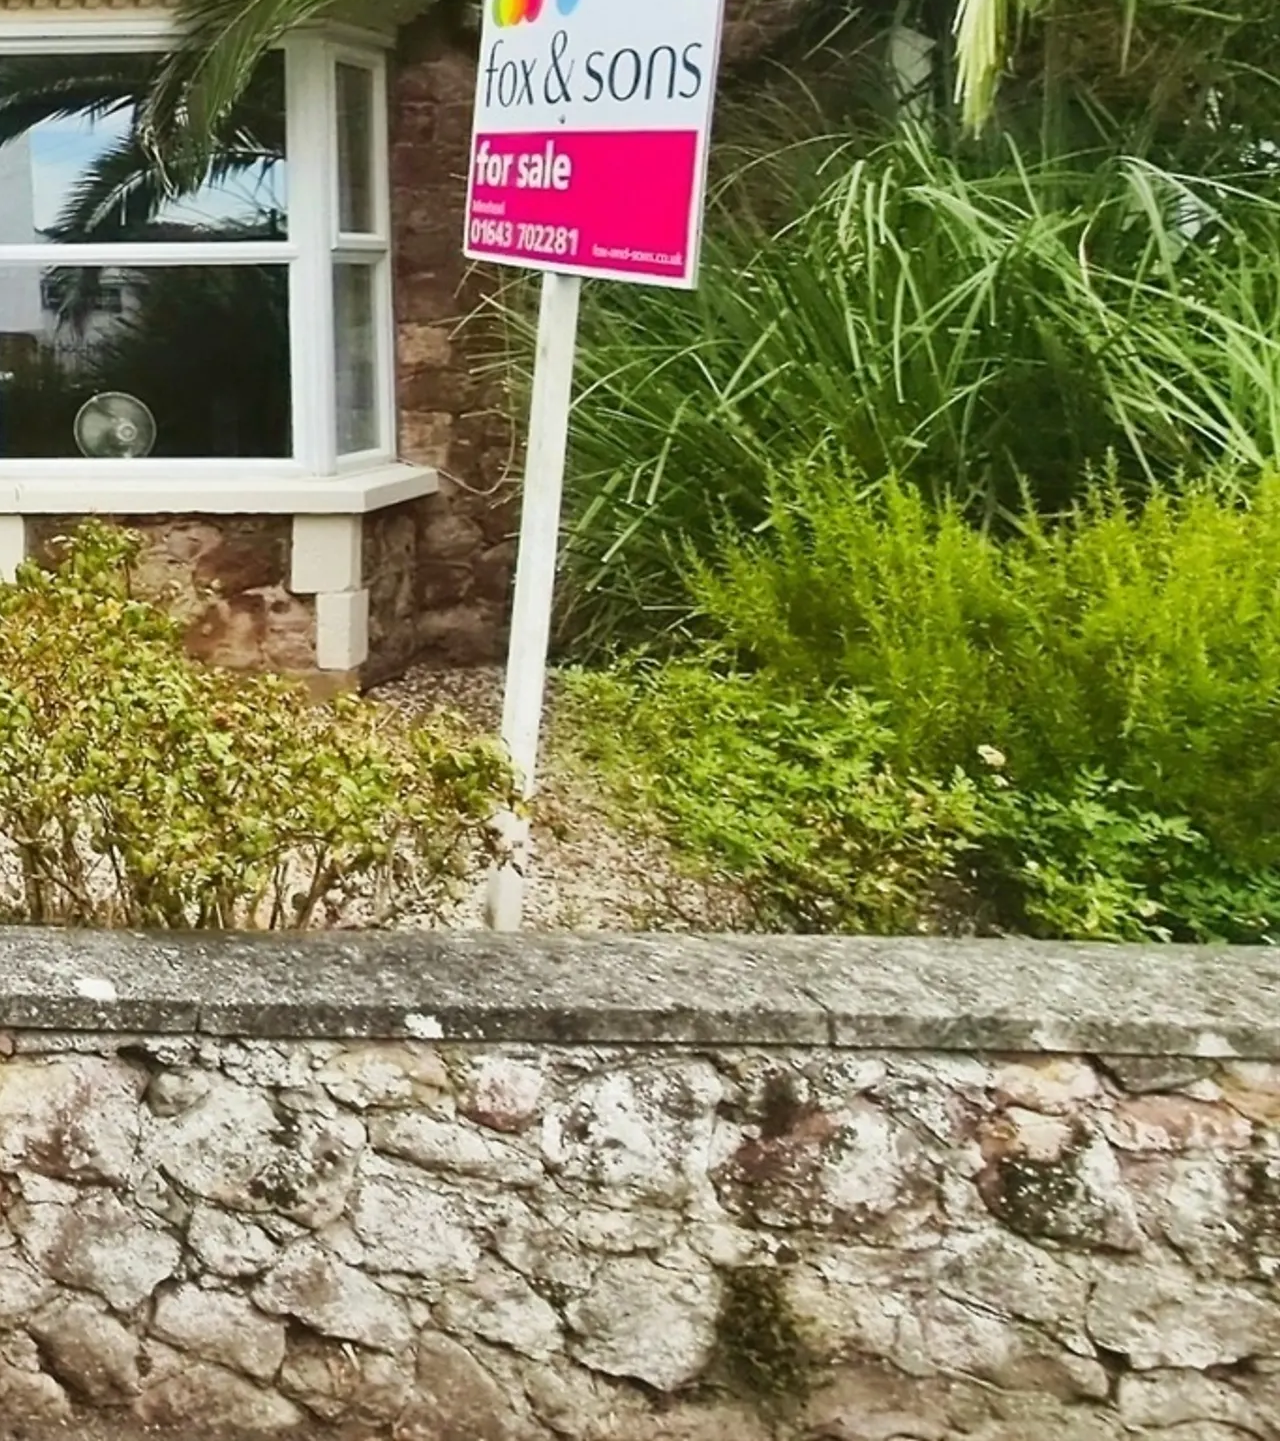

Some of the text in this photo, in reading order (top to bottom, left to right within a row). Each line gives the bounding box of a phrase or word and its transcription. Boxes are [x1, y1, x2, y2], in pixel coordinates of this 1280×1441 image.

[485, 30, 703, 107] fox & sons
[476, 140, 573, 190] for sale
[470, 217, 580, 256] 01643 702281
